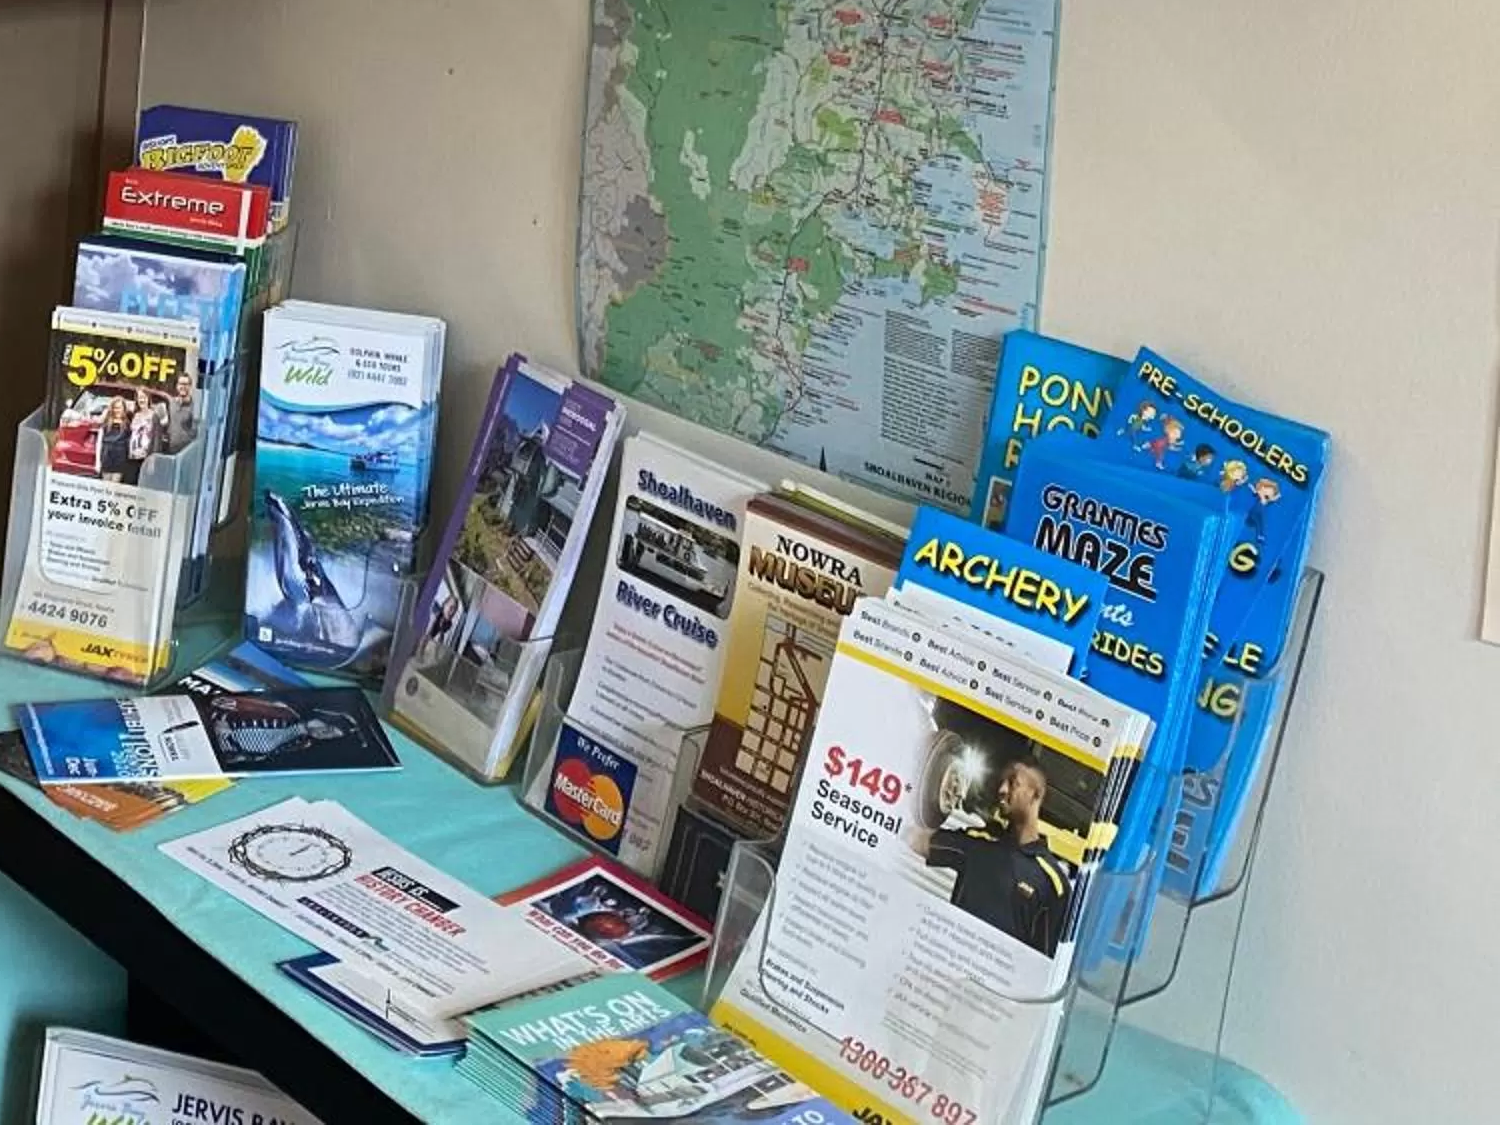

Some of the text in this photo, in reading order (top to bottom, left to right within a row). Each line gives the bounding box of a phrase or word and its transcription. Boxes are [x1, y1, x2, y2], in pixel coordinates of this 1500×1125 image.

[141, 143, 254, 171] BIGFOOT
[121, 186, 226, 216] Extreme
[283, 364, 334, 386] Wild
[1138, 360, 1309, 484] PRE-SCHOOLERS
[50, 490, 92, 510] Extra
[97, 500, 121, 516] 5%
[301, 481, 389, 498] The Ultimate
[332, 498, 351, 511] Bay
[637, 468, 738, 533] Shoalhaven
[933, 486, 973, 508] REGION
[47, 509, 75, 522] your
[78, 513, 124, 532] invoice
[775, 534, 863, 588] NOWRA
[1033, 516, 1157, 595] MAZE
[748, 544, 860, 617] MUSEU
[913, 538, 1088, 623] ARCHERY
[27, 600, 66, 620] 4424
[69, 608, 109, 628] 9076
[616, 579, 662, 620] River
[663, 604, 719, 650] Cruise
[80, 642, 115, 658] JAX
[927, 639, 1012, 684] Best Advice Best
[853, 630, 1091, 743] Best Best Advice Best Service Best Price
[576, 736, 620, 771] We Prefer
[553, 772, 622, 826] MasterCard
[816, 779, 903, 835] Seasonal
[811, 800, 879, 849] Service
[354, 875, 467, 937] HISTORY CHANGER
[527, 910, 608, 962] What can you do
[789, 971, 805, 985] and
[500, 990, 653, 1047] WHAT'S ON
[550, 1003, 673, 1052] IN THE ARTS
[803, 992, 830, 1015] Shocks
[838, 1036, 890, 1077] 1300
[886, 1067, 932, 1104] 367
[931, 1093, 978, 1125] 897
[172, 1092, 246, 1125] JERVIS
